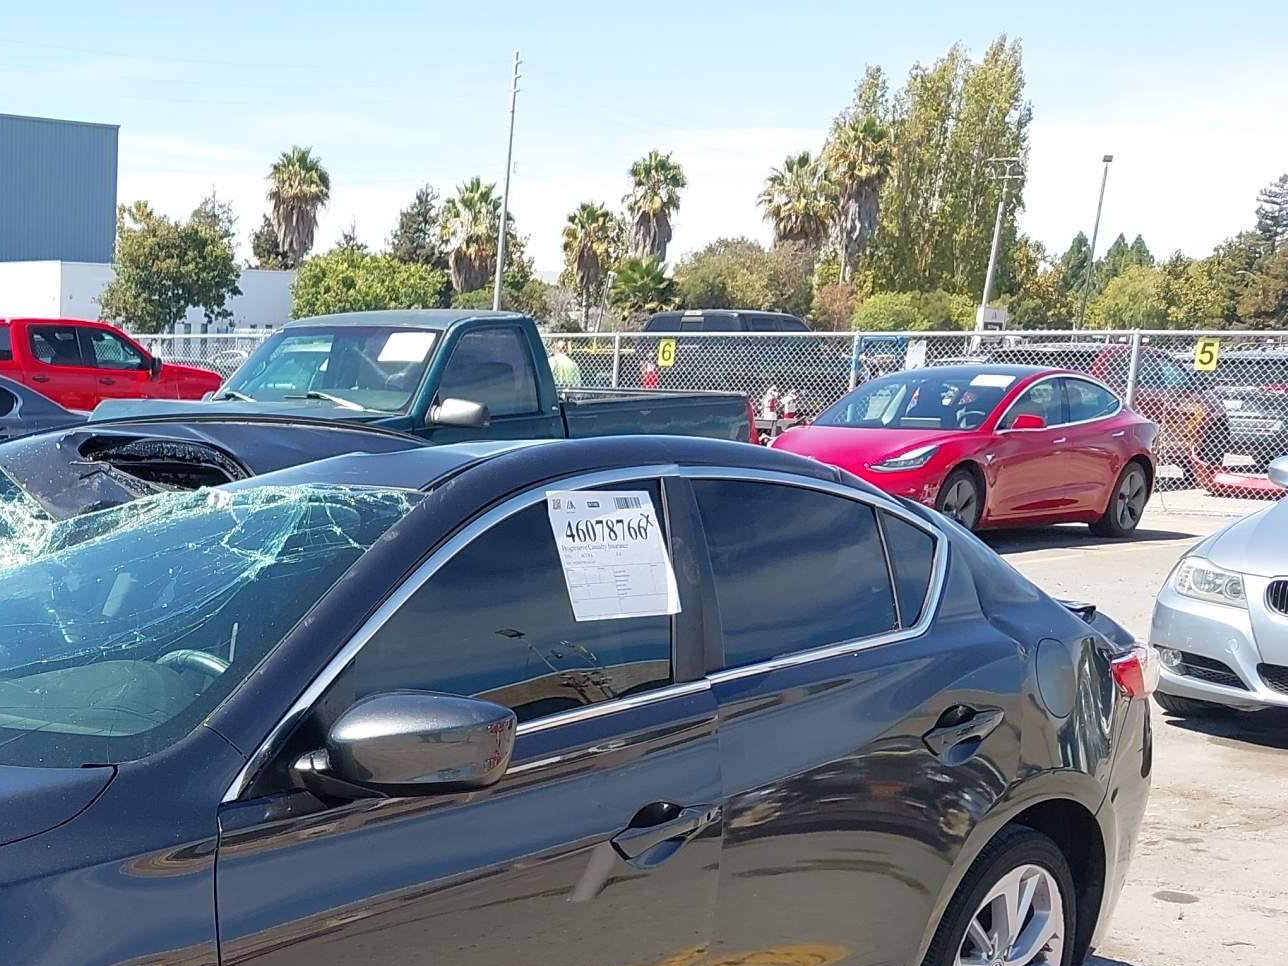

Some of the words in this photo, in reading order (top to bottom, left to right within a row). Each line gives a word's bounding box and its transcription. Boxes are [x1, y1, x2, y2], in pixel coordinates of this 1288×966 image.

[662, 342, 672, 361] 6
[1198, 342, 1215, 365] 5
[565, 518, 648, 543] 46078766
